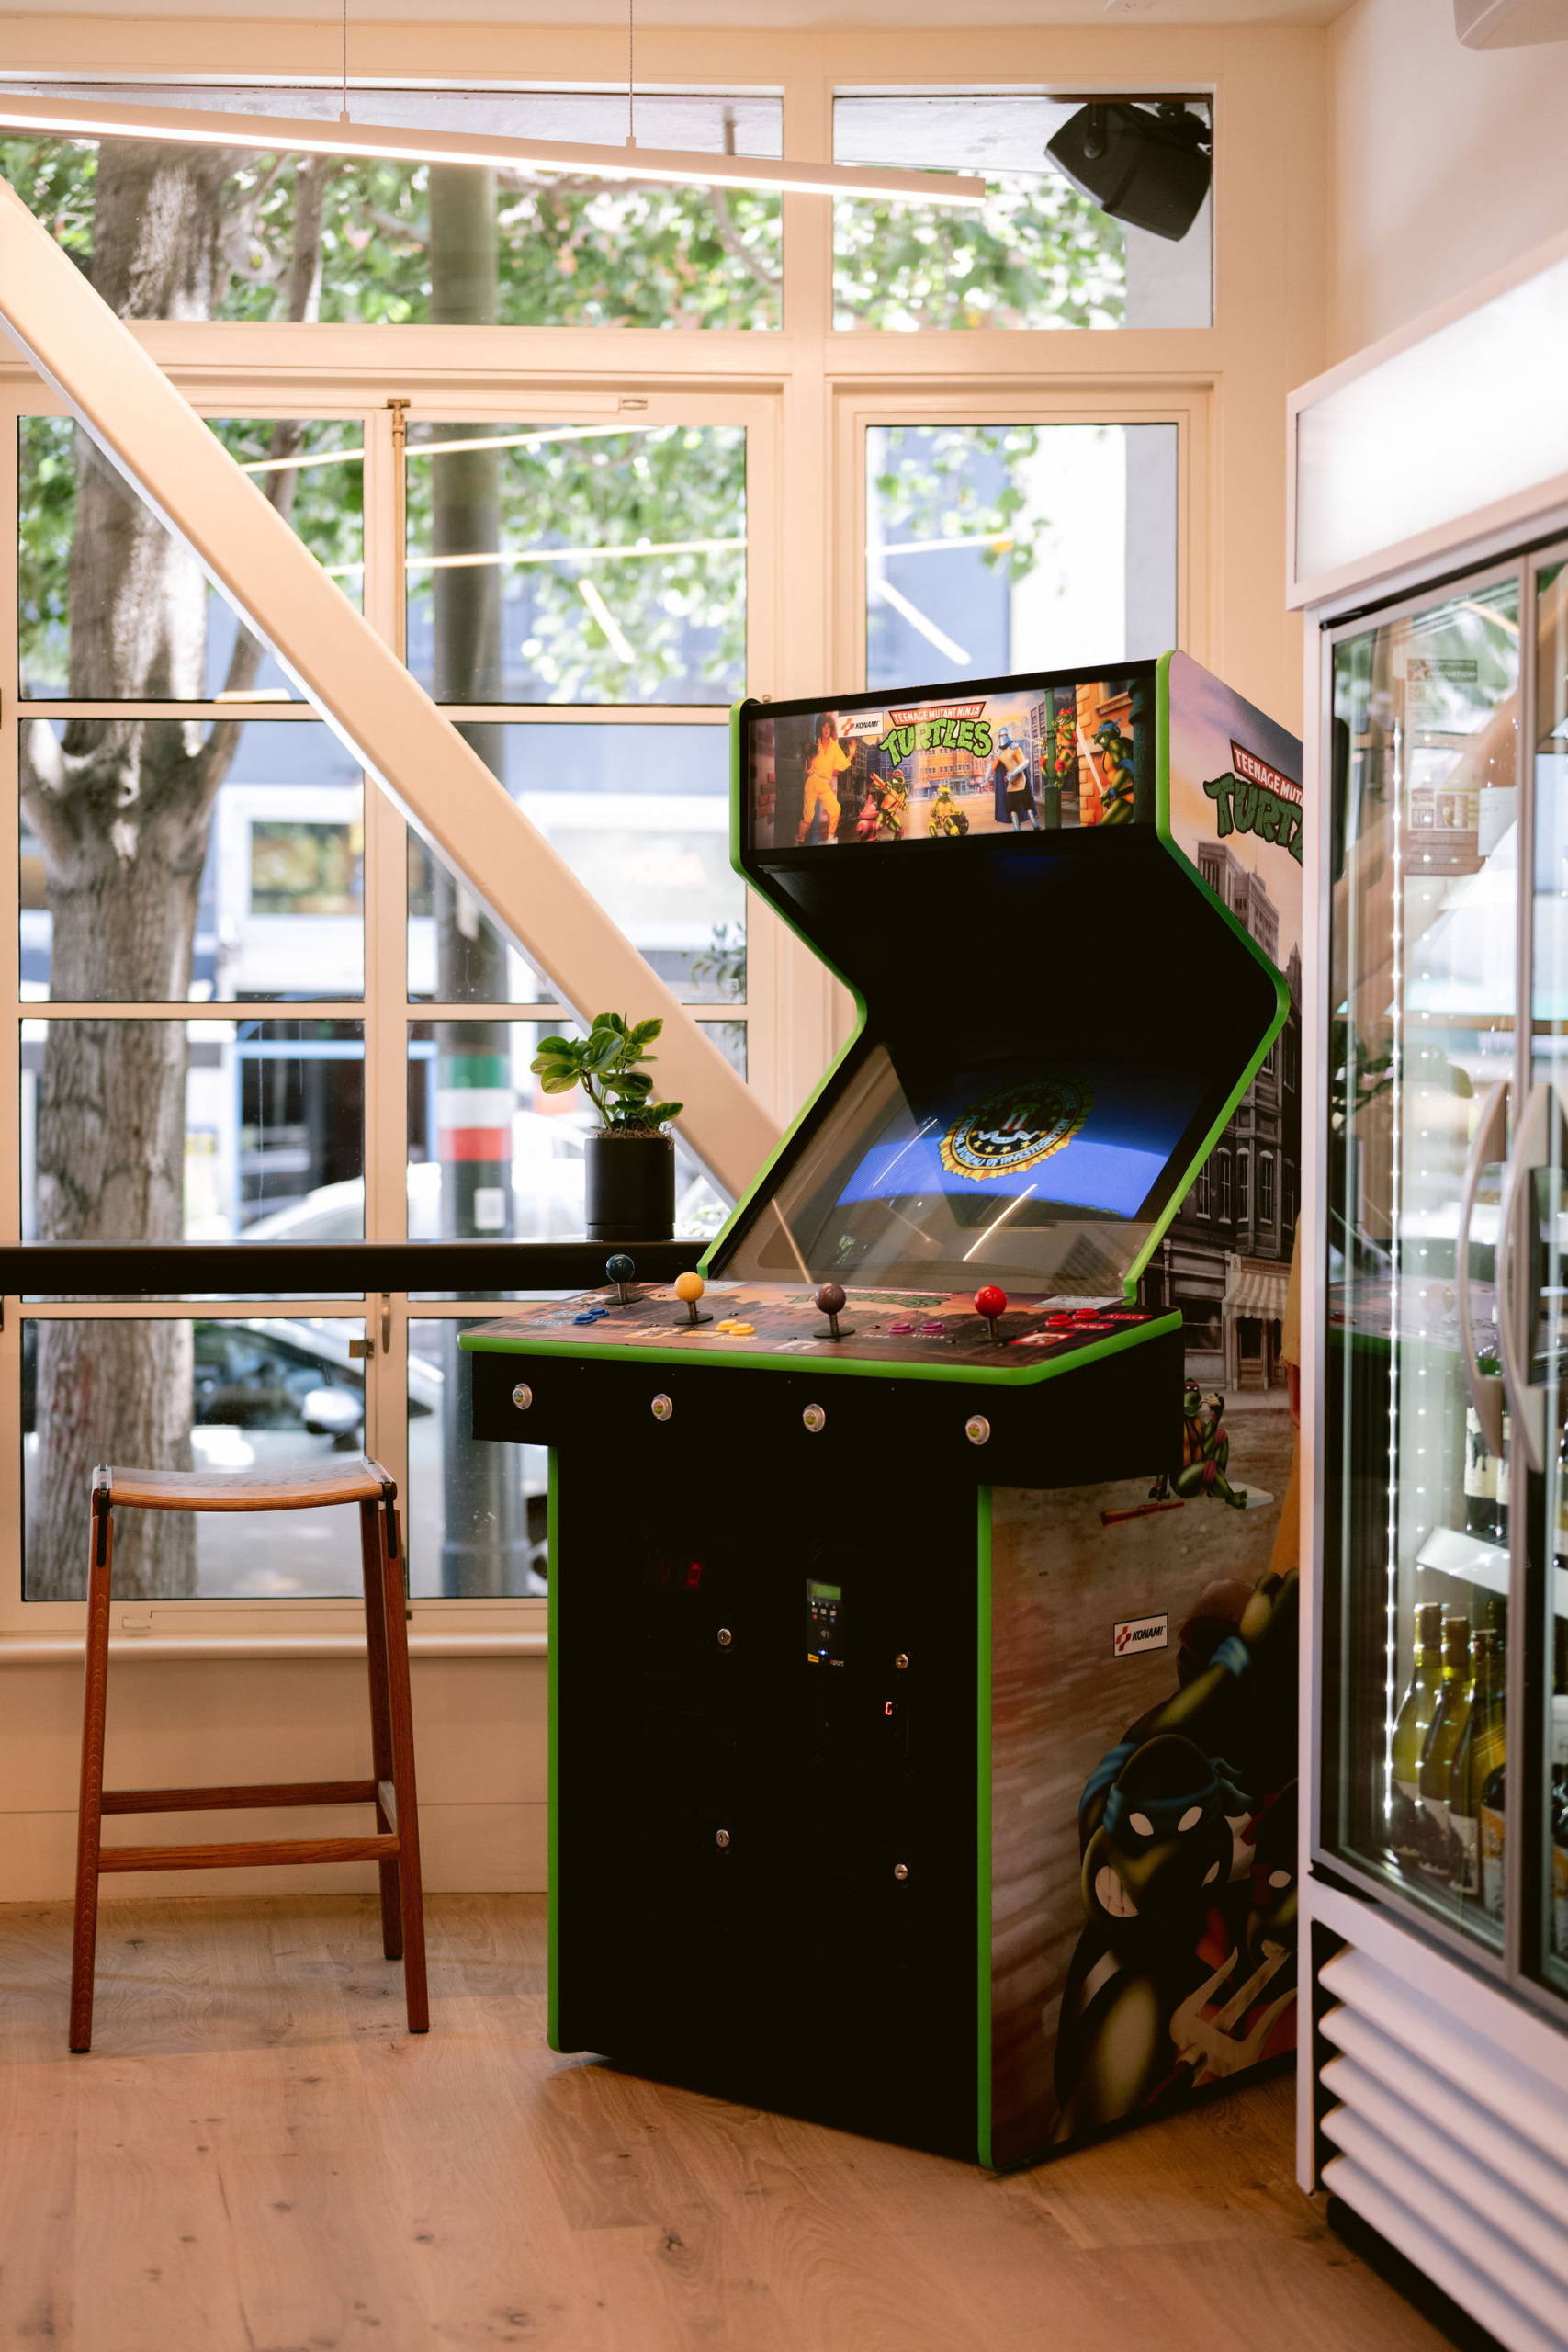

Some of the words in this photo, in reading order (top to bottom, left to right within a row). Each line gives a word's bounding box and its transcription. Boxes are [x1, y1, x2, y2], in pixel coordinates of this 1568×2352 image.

[892, 710, 928, 723] TEENAGE
[929, 707, 957, 719] MUTANT
[957, 706, 980, 717] NINJA
[855, 720, 879, 729] KONAMI
[877, 718, 993, 767] TURTLES
[1234, 748, 1280, 793] TEENAGE
[1132, 1626, 1163, 1642] KONAMI
